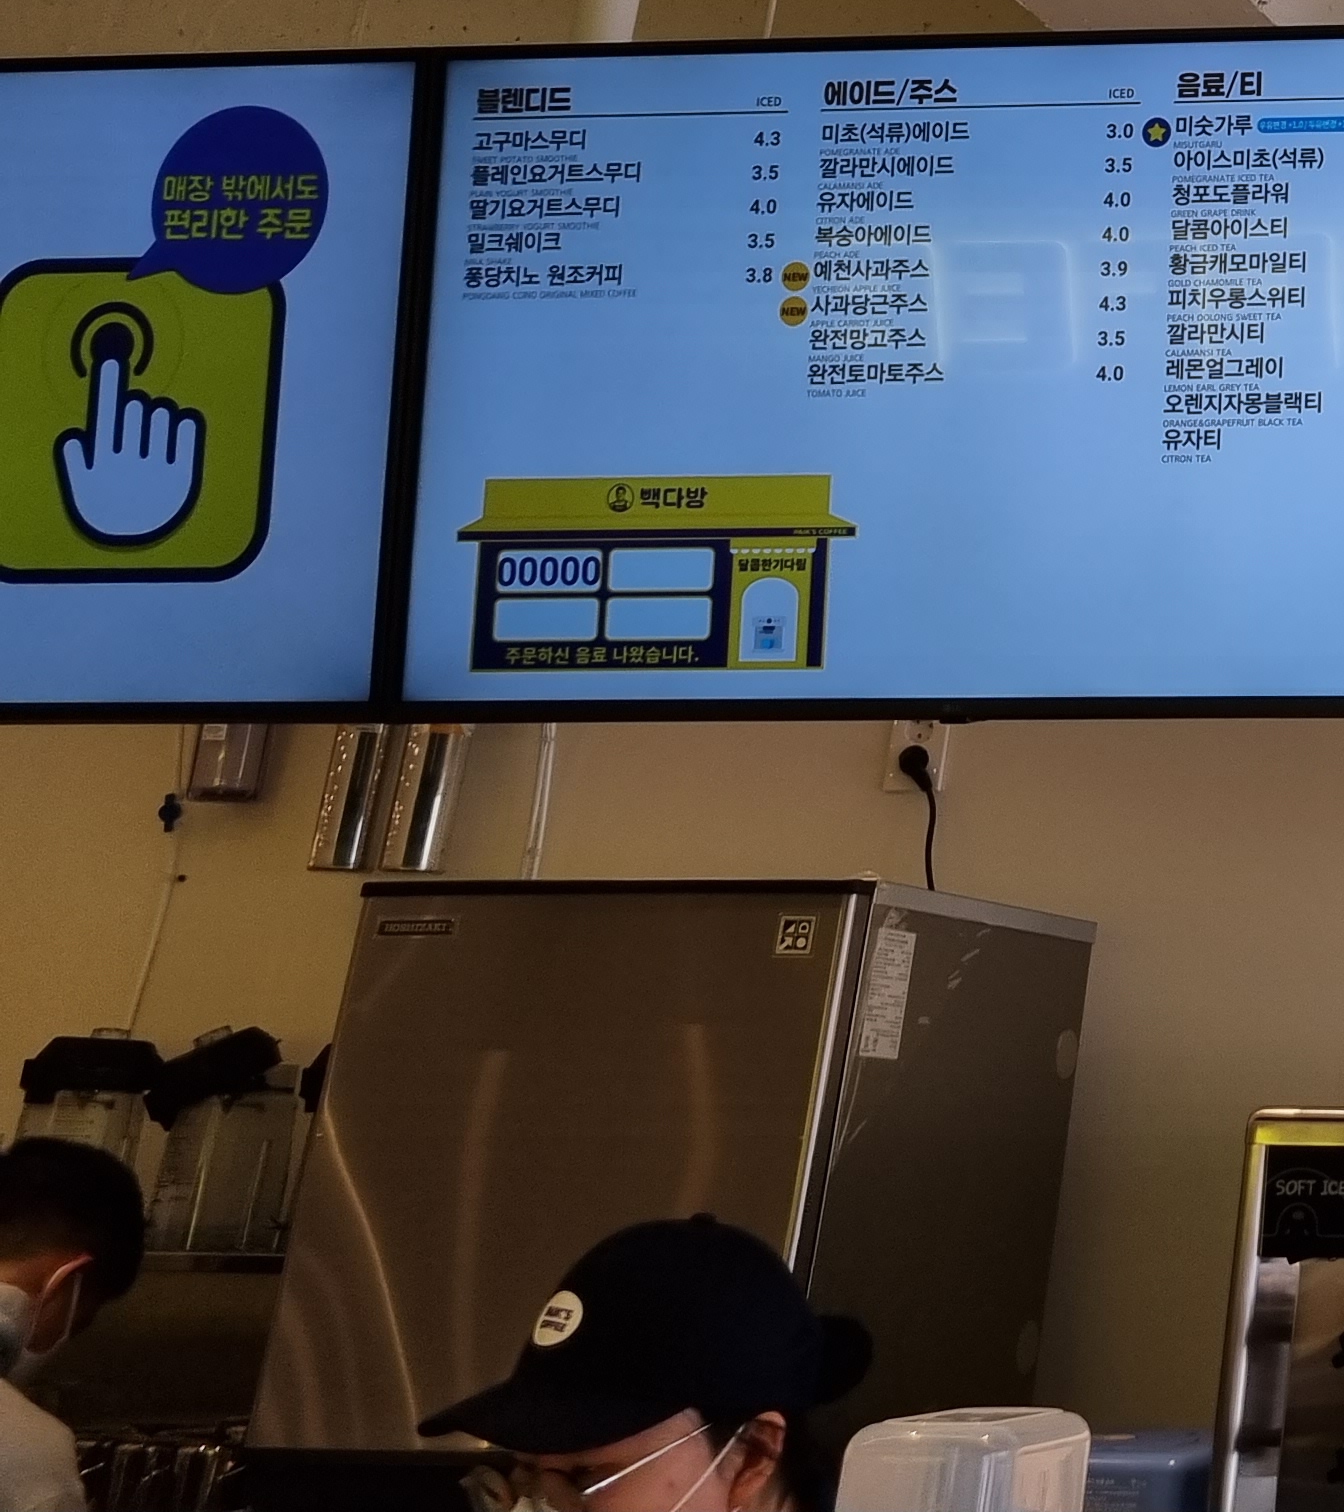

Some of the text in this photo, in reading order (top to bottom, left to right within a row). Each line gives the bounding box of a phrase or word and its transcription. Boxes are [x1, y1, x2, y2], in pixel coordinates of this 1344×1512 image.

[824, 79, 958, 106] 에이드/주스
[1177, 70, 1262, 99] 음료/티
[477, 87, 571, 113] 블렌디드
[756, 96, 781, 106] ICED
[822, 121, 969, 144] 미초(석류)에이드
[1176, 115, 1252, 137] 미숫가루
[473, 130, 781, 152] 고구마스무디 4.3
[820, 155, 954, 178] 깔라만시에이드
[1174, 147, 1324, 171] 아이스미초(석류)
[471, 162, 641, 186] 플레인요거트스무디
[163, 173, 319, 202] 매장 밖에서도
[1172, 182, 1289, 206] 청포도플라워
[470, 196, 620, 219] 딸기요거트스무디
[817, 191, 914, 213] 유자에이드
[164, 207, 312, 240] 편리한 주문
[1171, 217, 1288, 240] 달콤아이스티
[468, 231, 561, 253] 밀크쉐이크
[815, 225, 932, 247] 복숭아에이드
[783, 259, 1127, 282] NEW 예천사과주스 3.9
[1169, 252, 1307, 275] 황금캐모마일티
[464, 264, 622, 288] 퐁당치노 원조커피
[811, 294, 928, 316] 사과당근주스
[1168, 287, 1305, 310] 피치우롱스위티
[809, 329, 926, 351] 완전망고주스
[1167, 322, 1264, 345] 깔라만시티
[807, 363, 944, 386] 완전토마토주스
[1166, 356, 1283, 380] 레몬얼그레이
[807, 389, 866, 398] TOMATO JUICE
[1163, 392, 1322, 415] 오렌지자몽블랙티
[1162, 428, 1221, 451] 유자티
[1162, 454, 1211, 463] CITRON TEA
[640, 487, 708, 509] 빽다방
[499, 556, 600, 587] 00000
[506, 646, 699, 665] 주문하신 음료 나왔습니다.
[1276, 1180, 1316, 1196] SOFT
